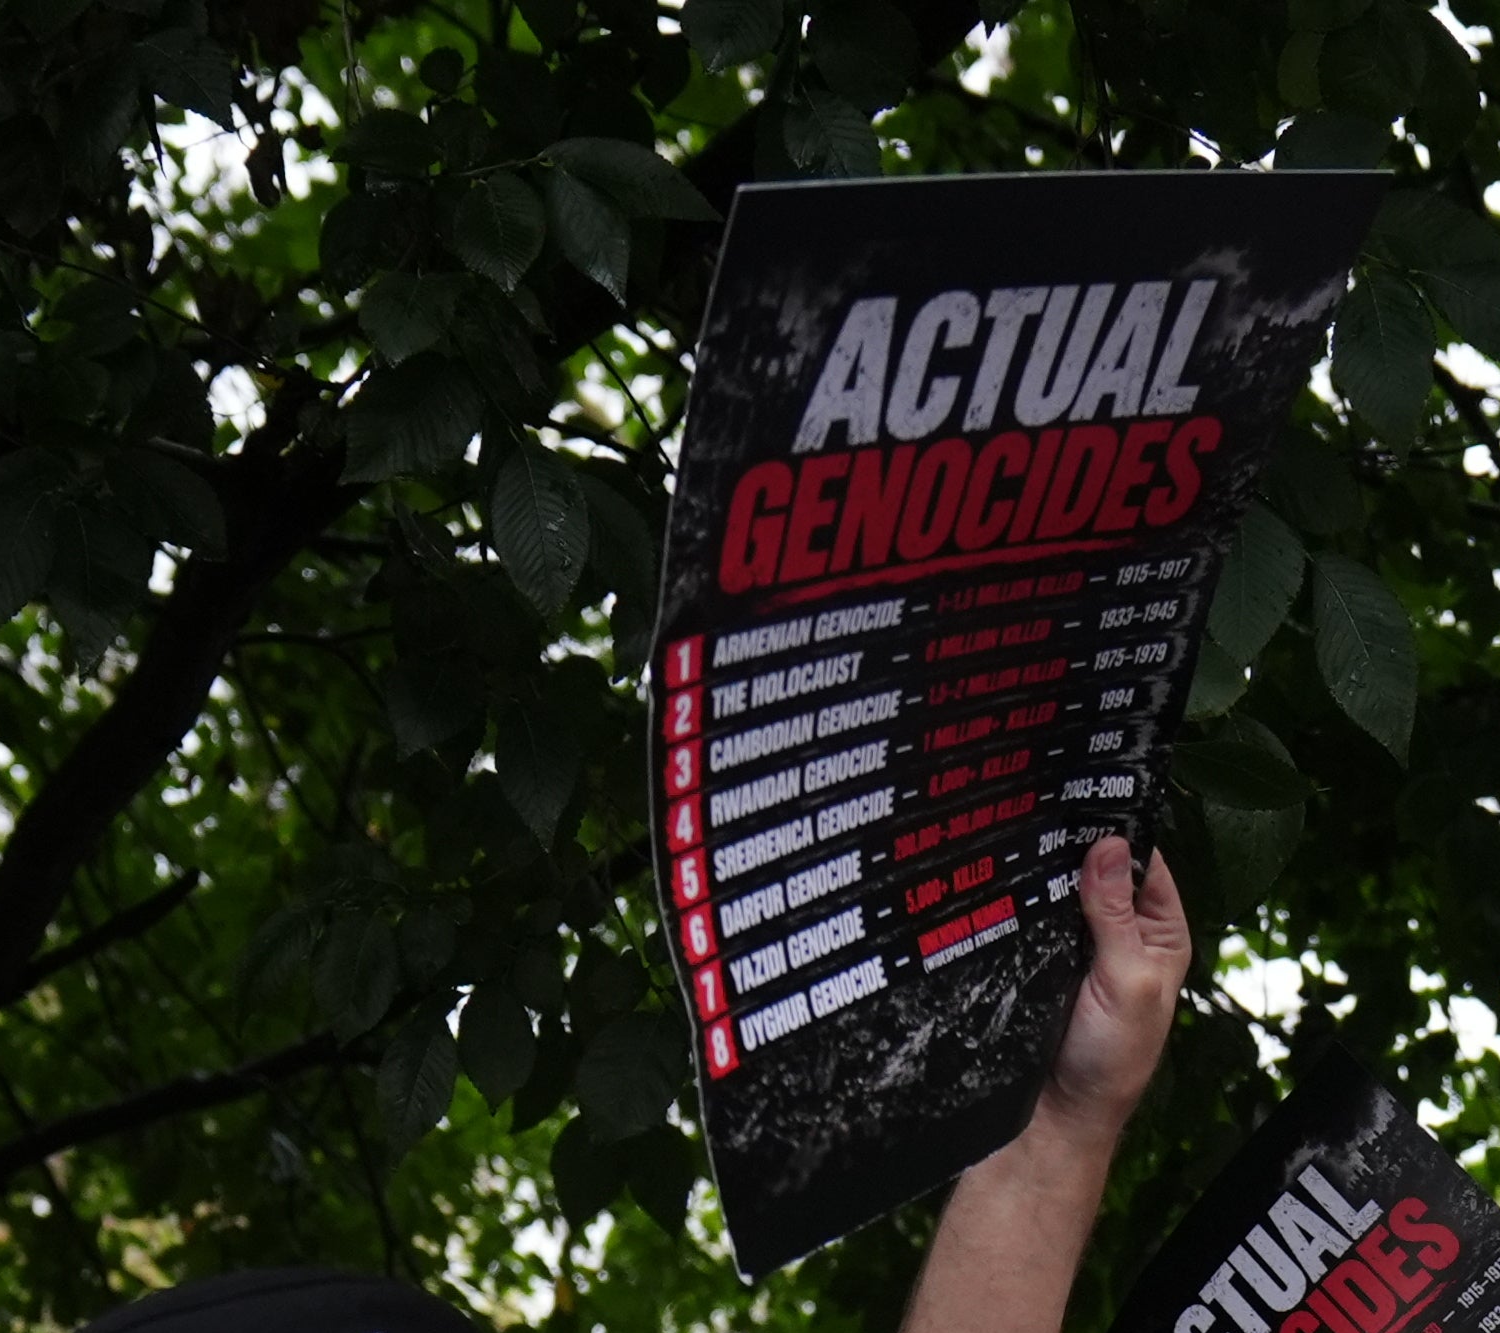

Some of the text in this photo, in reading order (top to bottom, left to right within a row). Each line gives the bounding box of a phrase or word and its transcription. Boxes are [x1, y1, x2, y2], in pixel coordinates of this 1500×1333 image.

[792, 280, 1217, 454] ACTUAL
[719, 416, 1222, 594] GENOCIDES
[675, 695, 692, 735] 2
[711, 681, 747, 720] THE
[751, 652, 863, 708] HOLOCAUST
[938, 629, 998, 659] MILLION
[1001, 619, 1052, 644] KILLED
[677, 643, 691, 681] 1
[712, 616, 813, 668] ARMENIAN
[814, 599, 903, 642] GENOCIDE
[1035, 571, 1084, 596] KILLED
[675, 750, 692, 788] 3
[710, 712, 814, 773] CAMBODIAN
[817, 690, 902, 737] GENOCIDE
[966, 667, 1021, 697] MILLION
[1022, 658, 1067, 682] KILLED
[675, 804, 694, 843] 4
[710, 767, 800, 827] RWANDAN
[804, 739, 889, 793] GENOCIDE
[1005, 702, 1057, 731] KILLED
[1099, 688, 1134, 711] 1994
[681, 858, 698, 900] 5
[713, 815, 814, 882] SREBRENICA
[817, 786, 894, 841] GENOCIDE
[981, 750, 1031, 780] KILLED
[1089, 731, 1124, 753] 1995
[689, 915, 707, 956] 6
[720, 883, 785, 938] DARFUR
[786, 850, 862, 909] GENOCIDE
[995, 792, 1036, 821] KILLED
[702, 971, 716, 1012] 7
[729, 941, 787, 994] YAZIDI
[787, 905, 866, 962] GENOCIDE
[953, 856, 994, 893] KILLED
[711, 1027, 729, 1068] 8
[739, 992, 812, 1051] UYGHUR
[809, 955, 888, 1018] GENOCIDE
